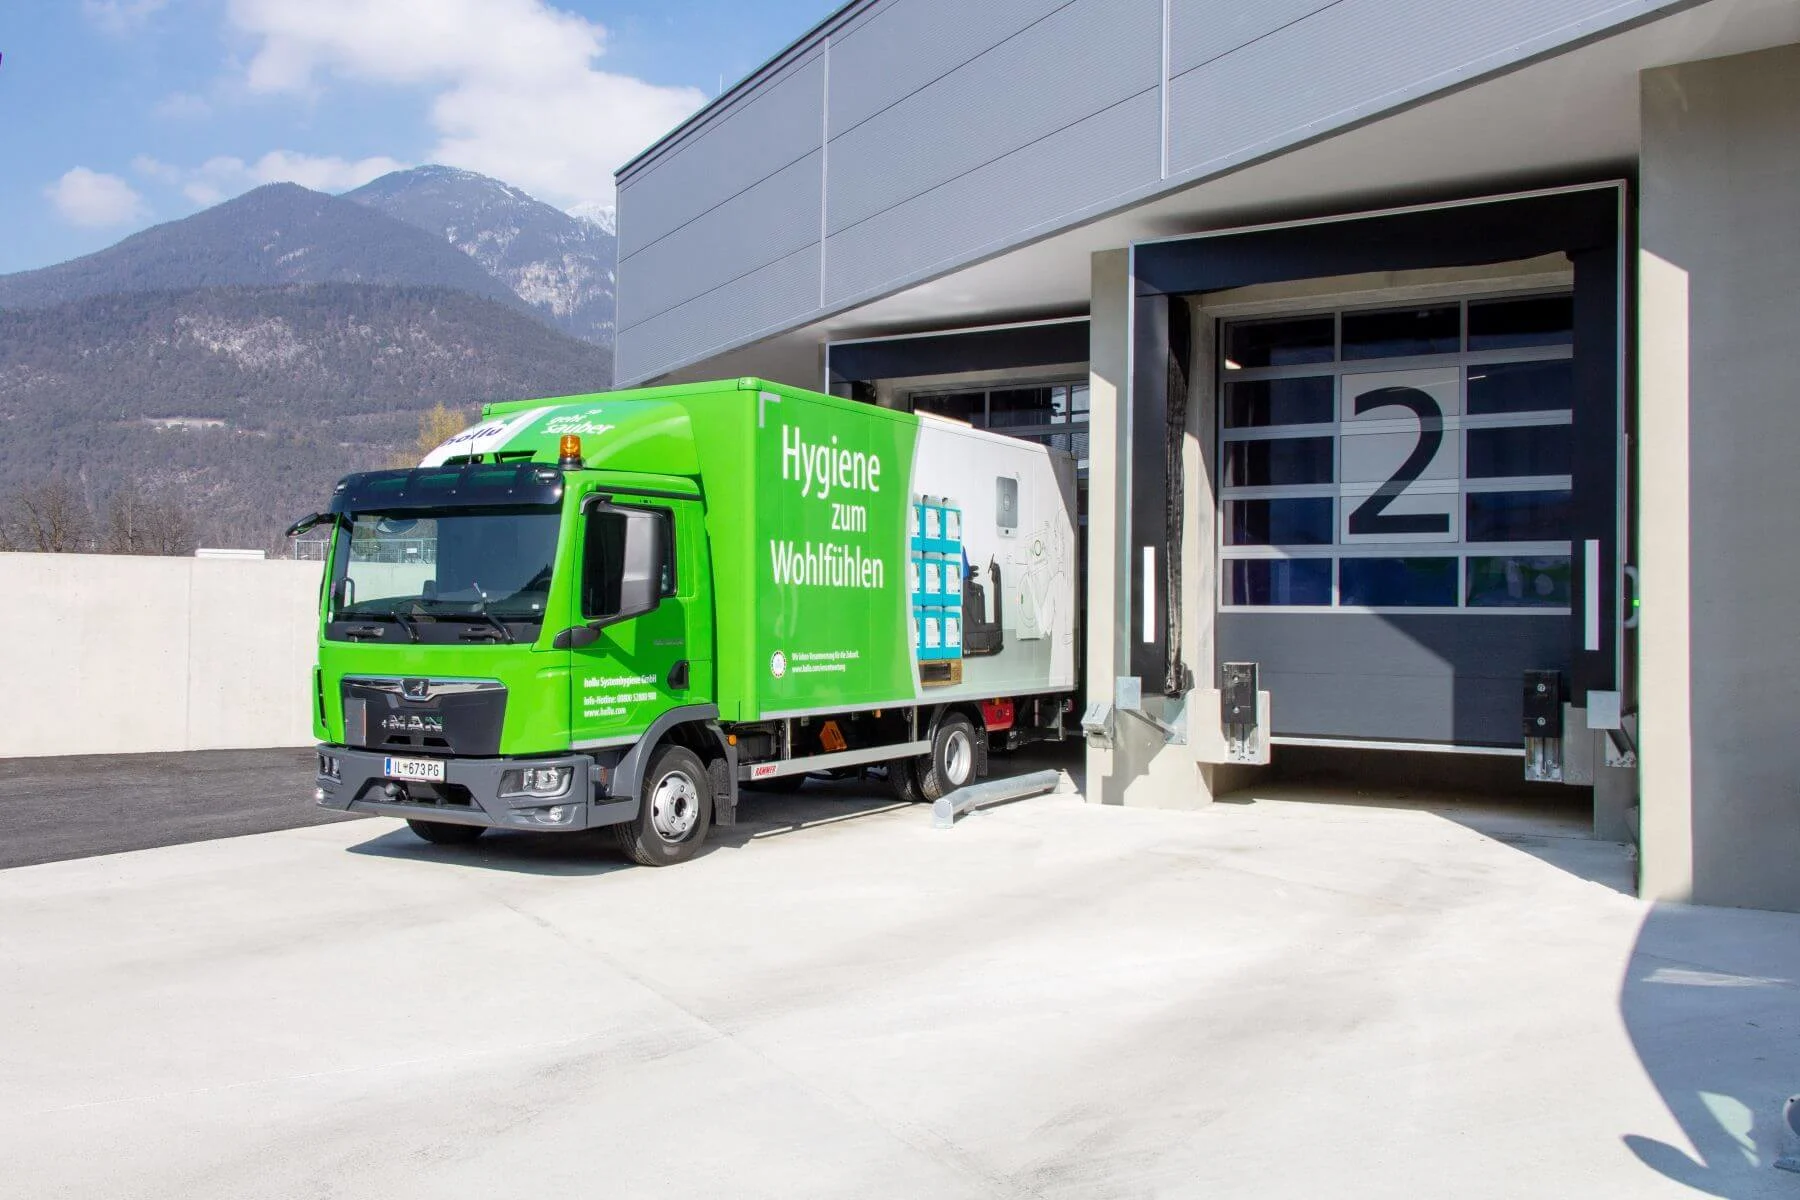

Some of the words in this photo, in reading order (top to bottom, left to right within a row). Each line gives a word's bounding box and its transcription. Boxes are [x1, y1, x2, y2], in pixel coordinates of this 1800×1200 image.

[540, 420, 615, 435] sauber
[782, 424, 881, 500] Hygiene
[1349, 386, 1443, 534] 2
[831, 503, 867, 533] zum
[770, 539, 884, 589] Wohlfühlen
[389, 714, 442, 732] MAN
